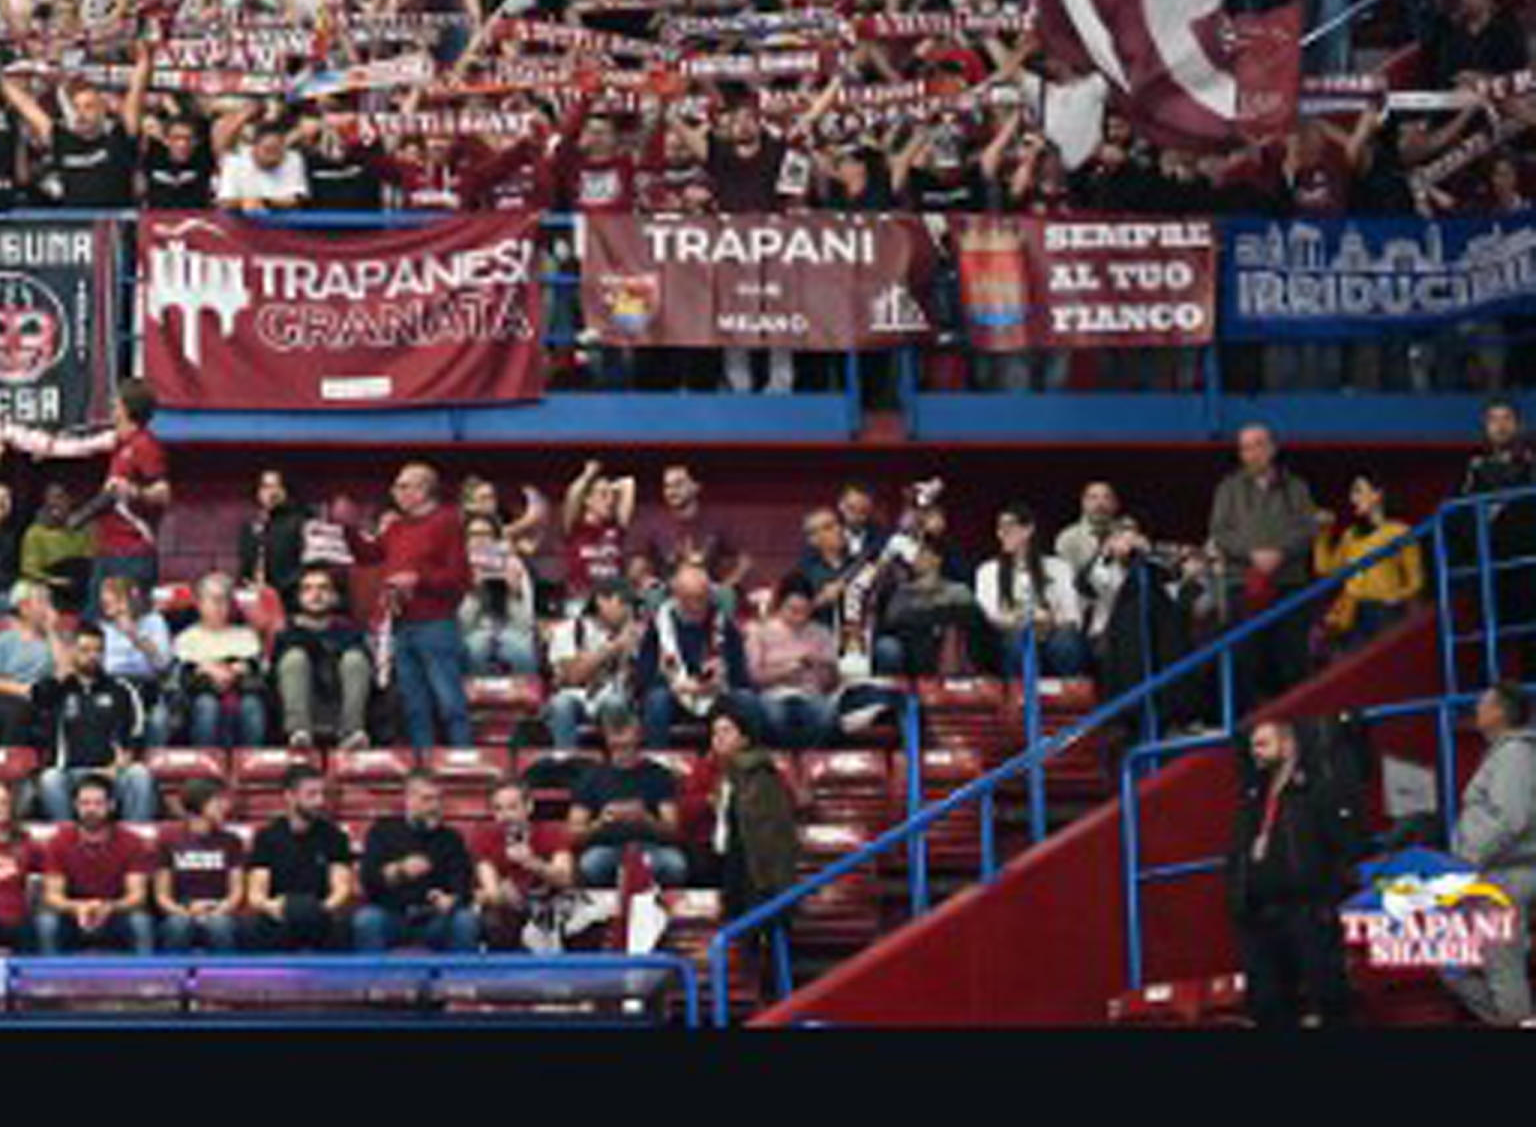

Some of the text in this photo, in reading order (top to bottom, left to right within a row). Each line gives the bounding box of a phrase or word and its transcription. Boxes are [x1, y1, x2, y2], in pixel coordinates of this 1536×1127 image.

[643, 225, 875, 266] TRAPANI
[1045, 224, 1211, 250] SEMPRE
[253, 239, 533, 299] TRAPANESI
[1049, 261, 1194, 291] AL TUO
[255, 289, 533, 351] GRANATA
[1051, 303, 1204, 333] FIANCO
